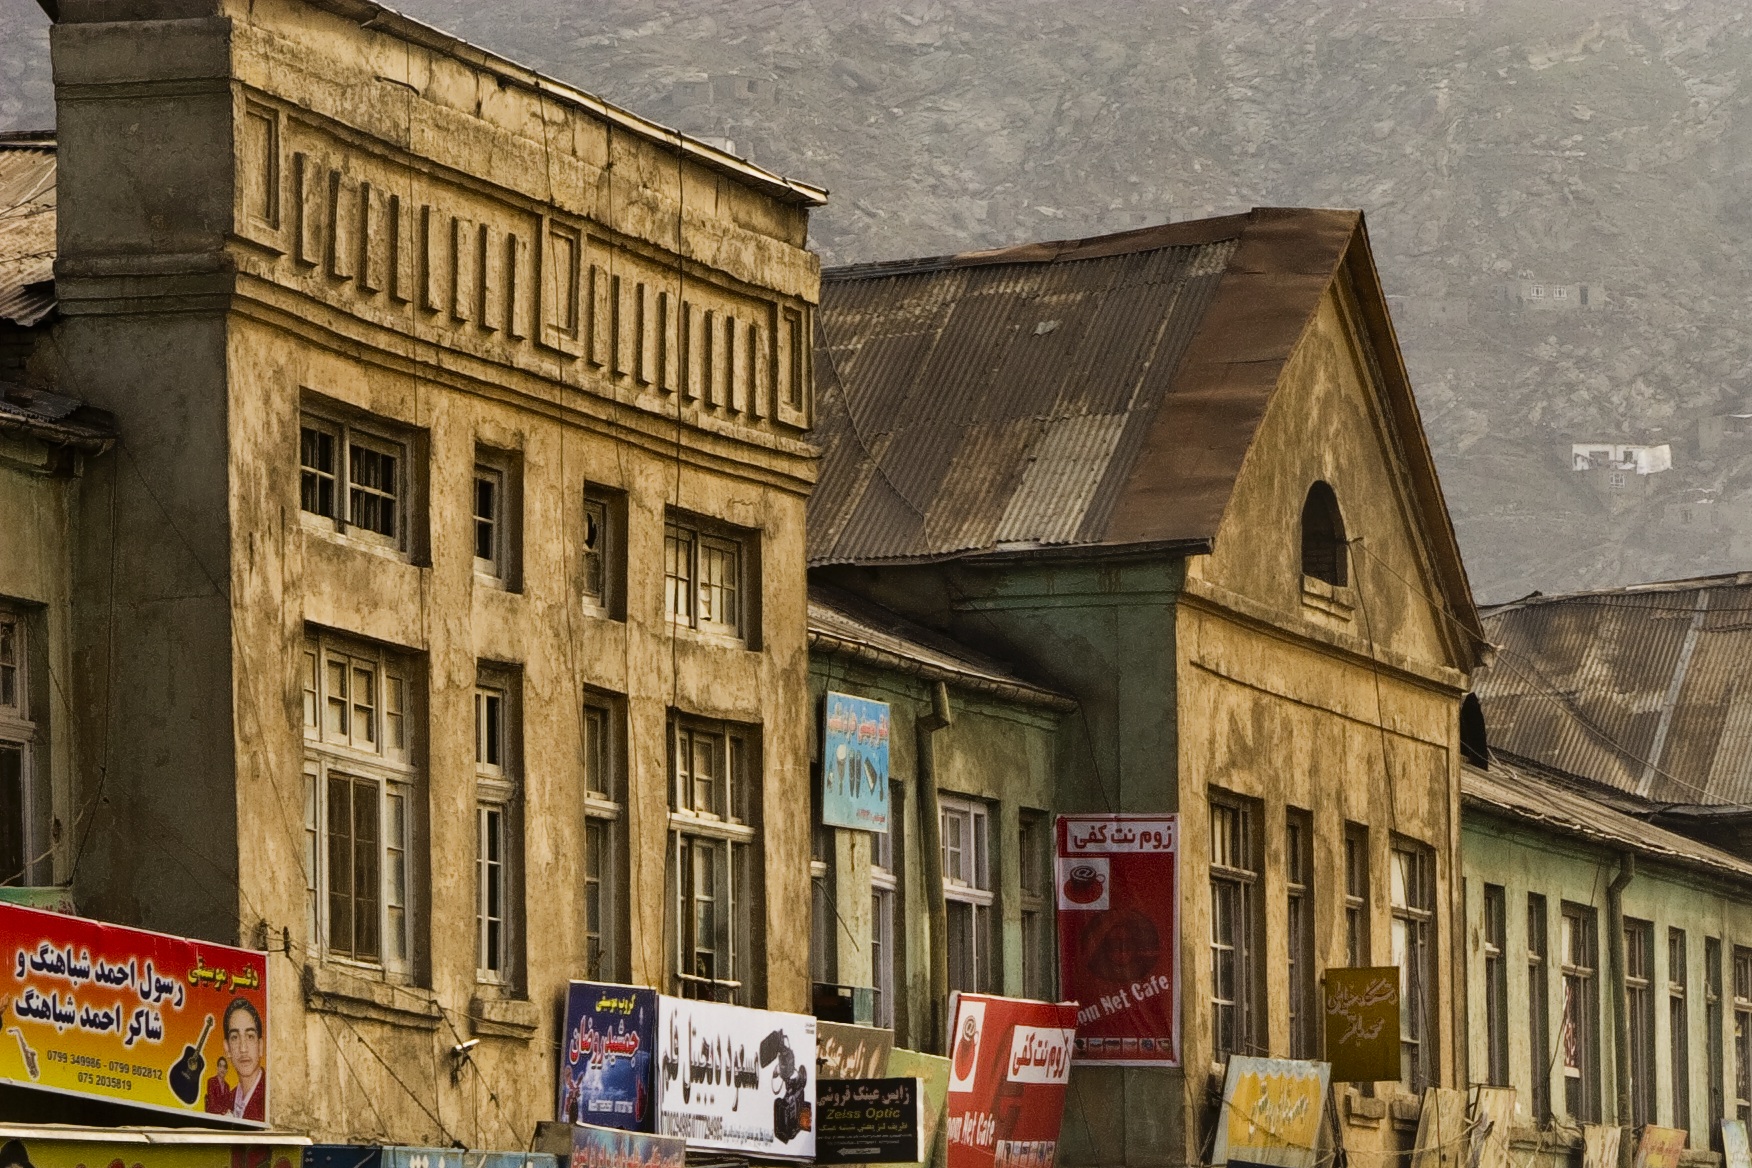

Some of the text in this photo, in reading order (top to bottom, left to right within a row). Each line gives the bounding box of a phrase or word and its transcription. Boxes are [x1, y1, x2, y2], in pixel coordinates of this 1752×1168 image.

[1073, 823, 1172, 850] زوم نت کفی
[16, 943, 184, 1006] رسول احمد شباهنگ و
[1101, 989, 1131, 1016] Net
[1131, 975, 1169, 1000] Cafe
[15, 989, 163, 1045] شاکر احمد شباهنگ
[109, 1061, 129, 1074] 0799
[1012, 1031, 1035, 1077] کفی
[1033, 1038, 1049, 1067] نت
[726, 1034, 759, 1112] مسعود
[865, 1107, 900, 1121] Optic
[961, 1111, 977, 1147] Net
[976, 1112, 995, 1146] Cafe
